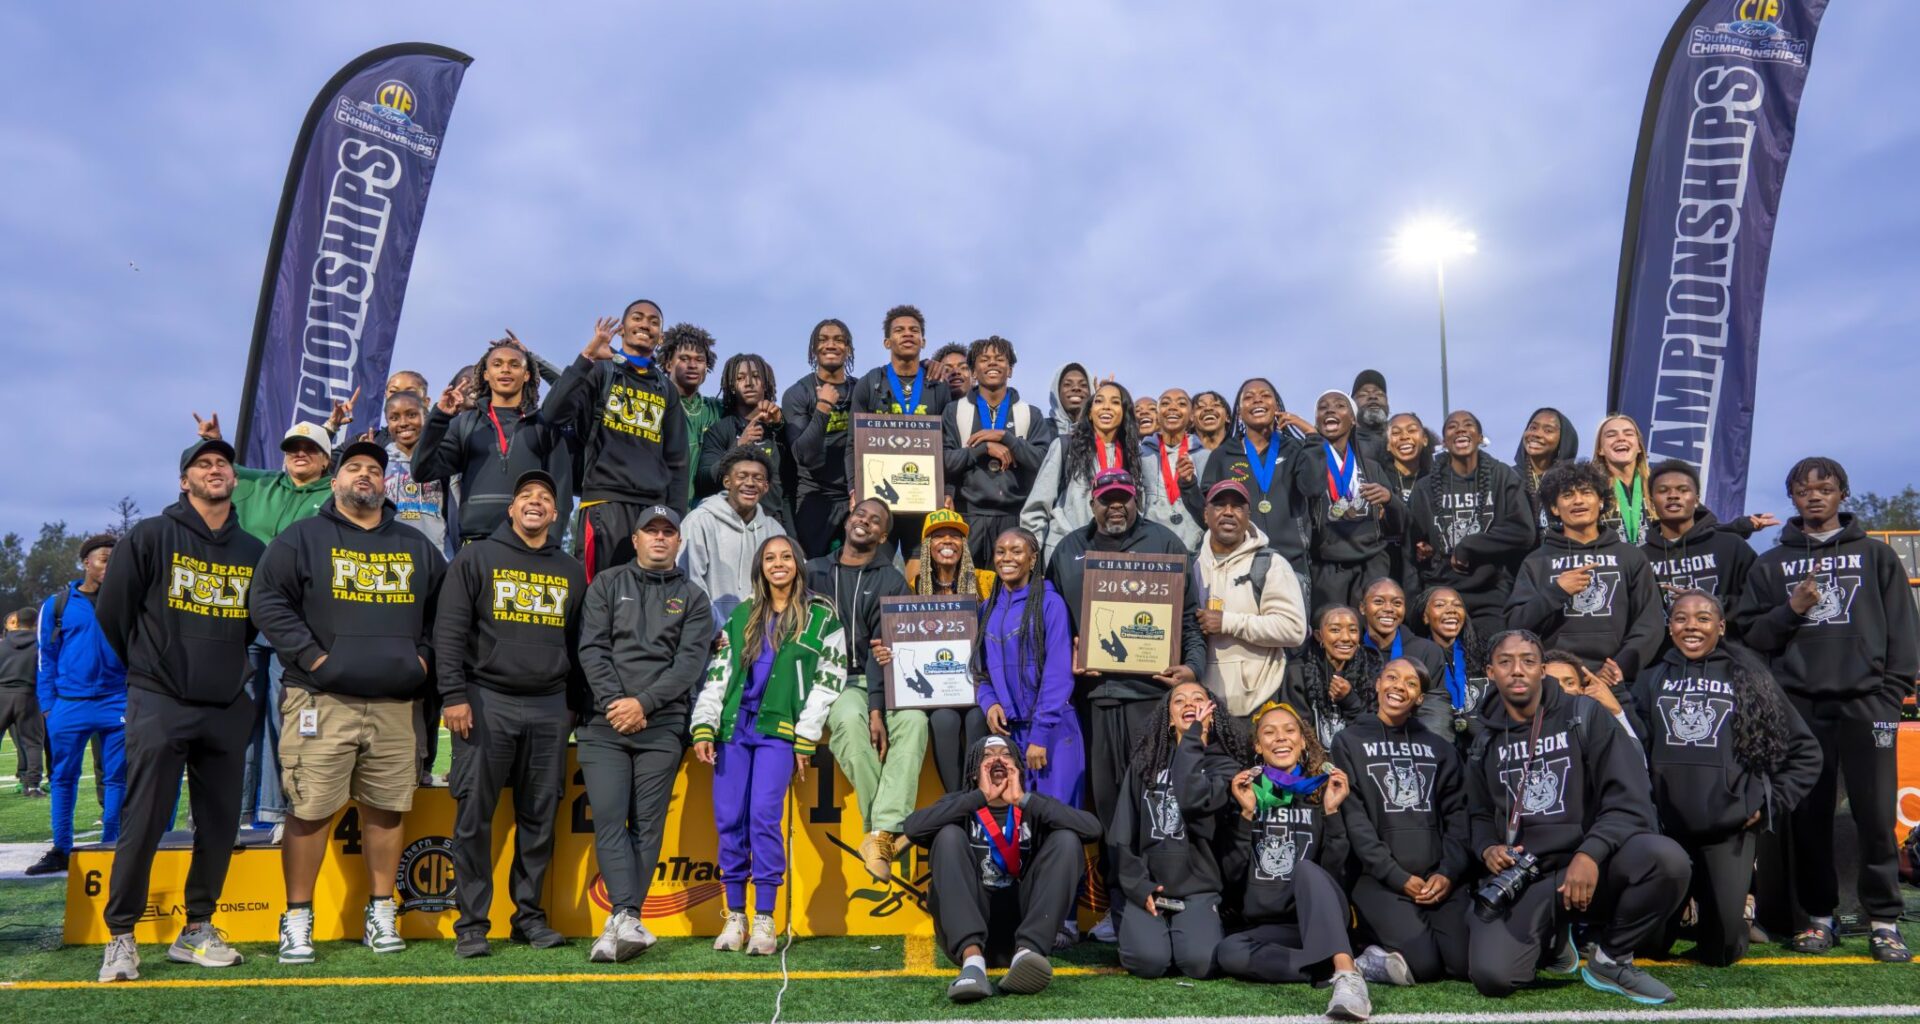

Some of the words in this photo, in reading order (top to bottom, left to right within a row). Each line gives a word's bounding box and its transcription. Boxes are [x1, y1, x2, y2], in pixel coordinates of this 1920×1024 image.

[1740, 0, 1778, 21] CIF
[1738, 23, 1769, 37] Ford
[1694, 29, 1752, 48] Southern
[1759, 39, 1805, 53] Section
[1691, 43, 1803, 63] CHAMPIONSHIPS
[379, 84, 413, 113] CIF
[340, 99, 391, 131] Southern
[397, 127, 436, 146] Section
[378, 106, 407, 125] Ford
[336, 110, 433, 156] CHAMPIONSHIPS
[603, 417, 634, 434] TRACK
[867, 420, 931, 428] CHAMPIONS
[868, 436, 885, 447] 20
[913, 438, 931, 448] 25
[370, 552, 412, 562] BEACH
[1098, 561, 1171, 571] CHAMPIONS
[1552, 554, 1618, 569] WILSON
[1650, 554, 1717, 575] WILSON
[211, 562, 253, 577] BEACH
[332, 557, 415, 593] POLY
[168, 565, 251, 608] POLY
[530, 573, 568, 587] BEACH
[1098, 580, 1117, 593] 20
[1149, 583, 1169, 596] 25
[333, 589, 373, 602] TRACK
[376, 594, 383, 603] &
[386, 594, 415, 603] FIELD
[493, 579, 568, 616] POLY
[168, 598, 209, 615] TRACK
[213, 607, 219, 616] &
[222, 609, 249, 618] FIELD
[898, 602, 961, 612] FINALISTS
[493, 611, 530, 623] TRACK
[533, 616, 539, 624] &
[897, 621, 915, 634] 20
[946, 621, 965, 632] 25
[1663, 677, 1734, 695] WILSON
[1363, 741, 1435, 758] WILSON
[810, 744, 842, 823] 1
[334, 806, 362, 855] 4
[396, 838, 432, 890] Southern
[85, 869, 102, 896] 6
[413, 853, 455, 895] CIF
